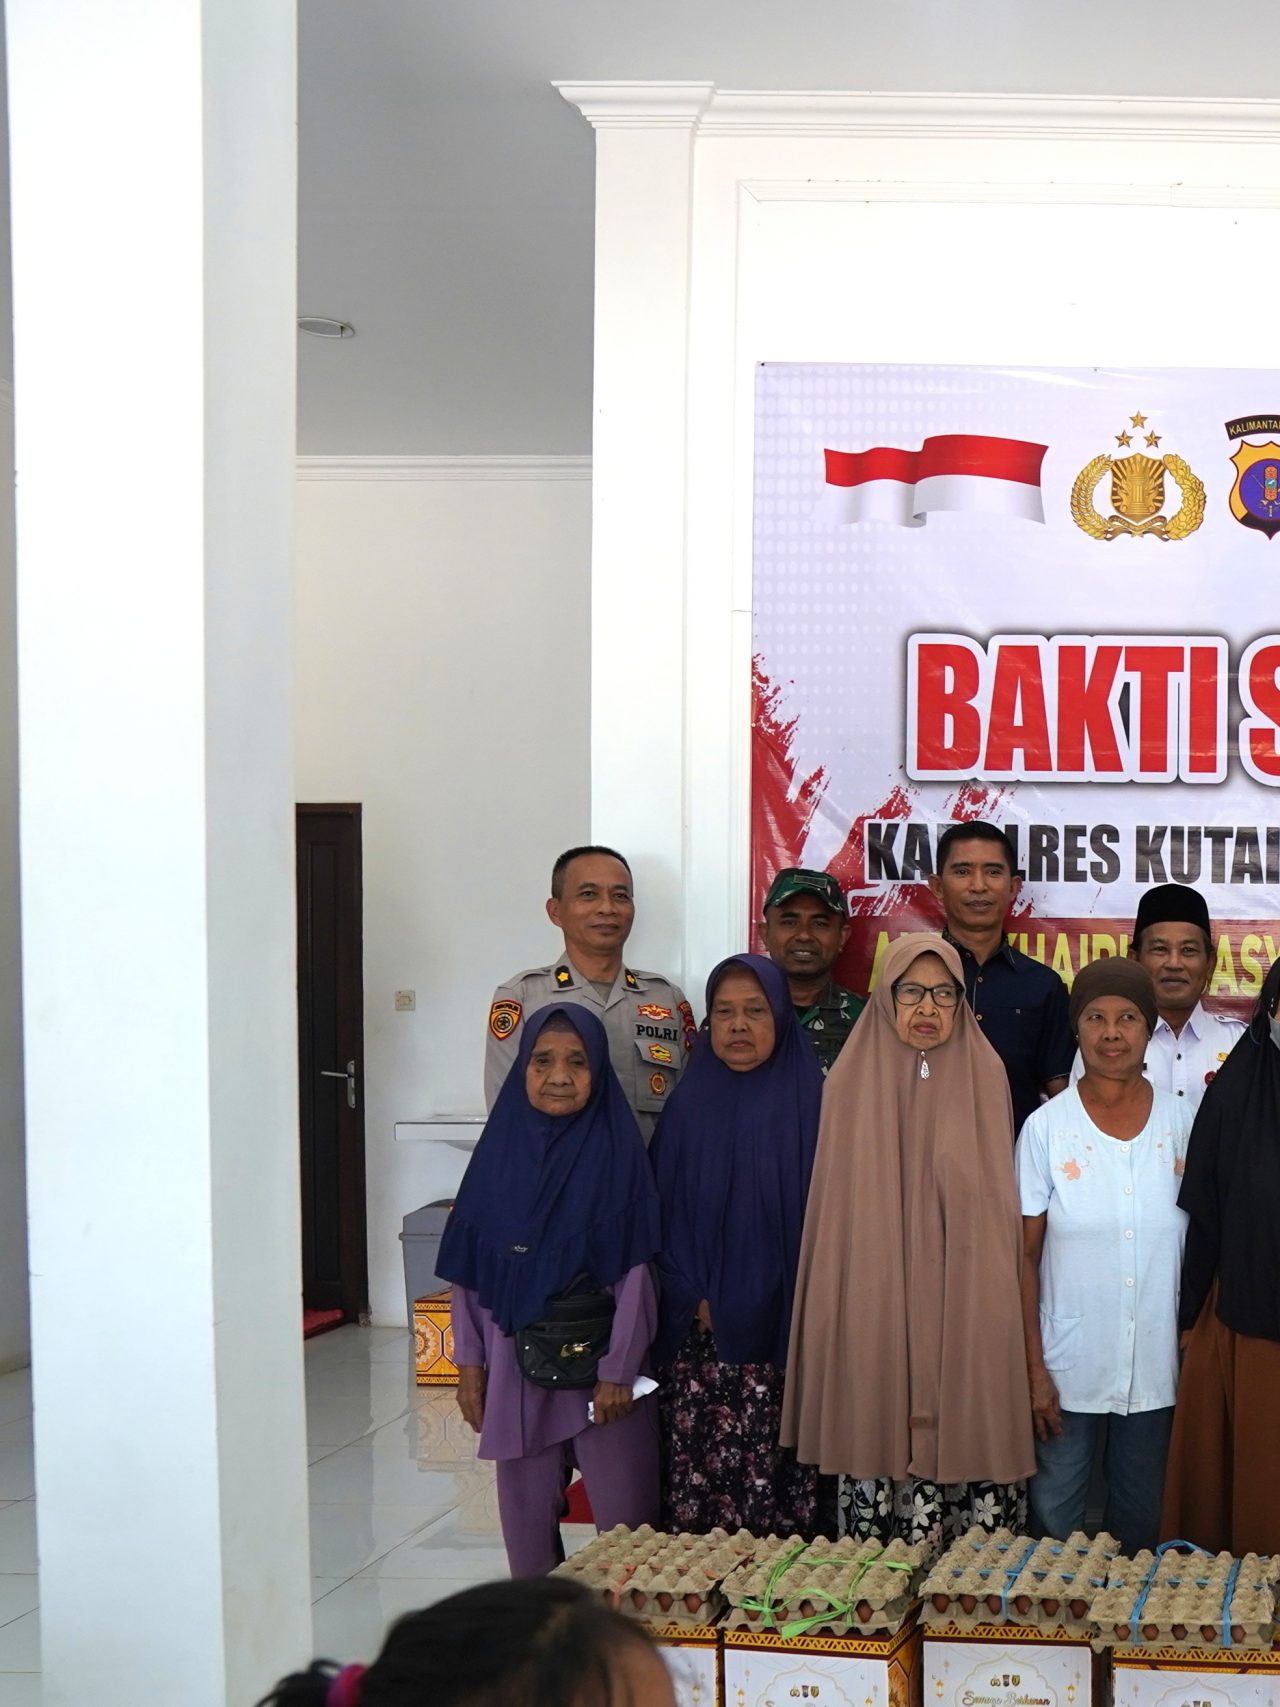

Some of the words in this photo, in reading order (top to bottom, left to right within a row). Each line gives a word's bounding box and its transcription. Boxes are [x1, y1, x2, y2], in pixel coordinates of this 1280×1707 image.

[915, 643, 1219, 775] BAKTI
[1135, 826, 1280, 884] KUTAI
[635, 1023, 679, 1042] POLRI
